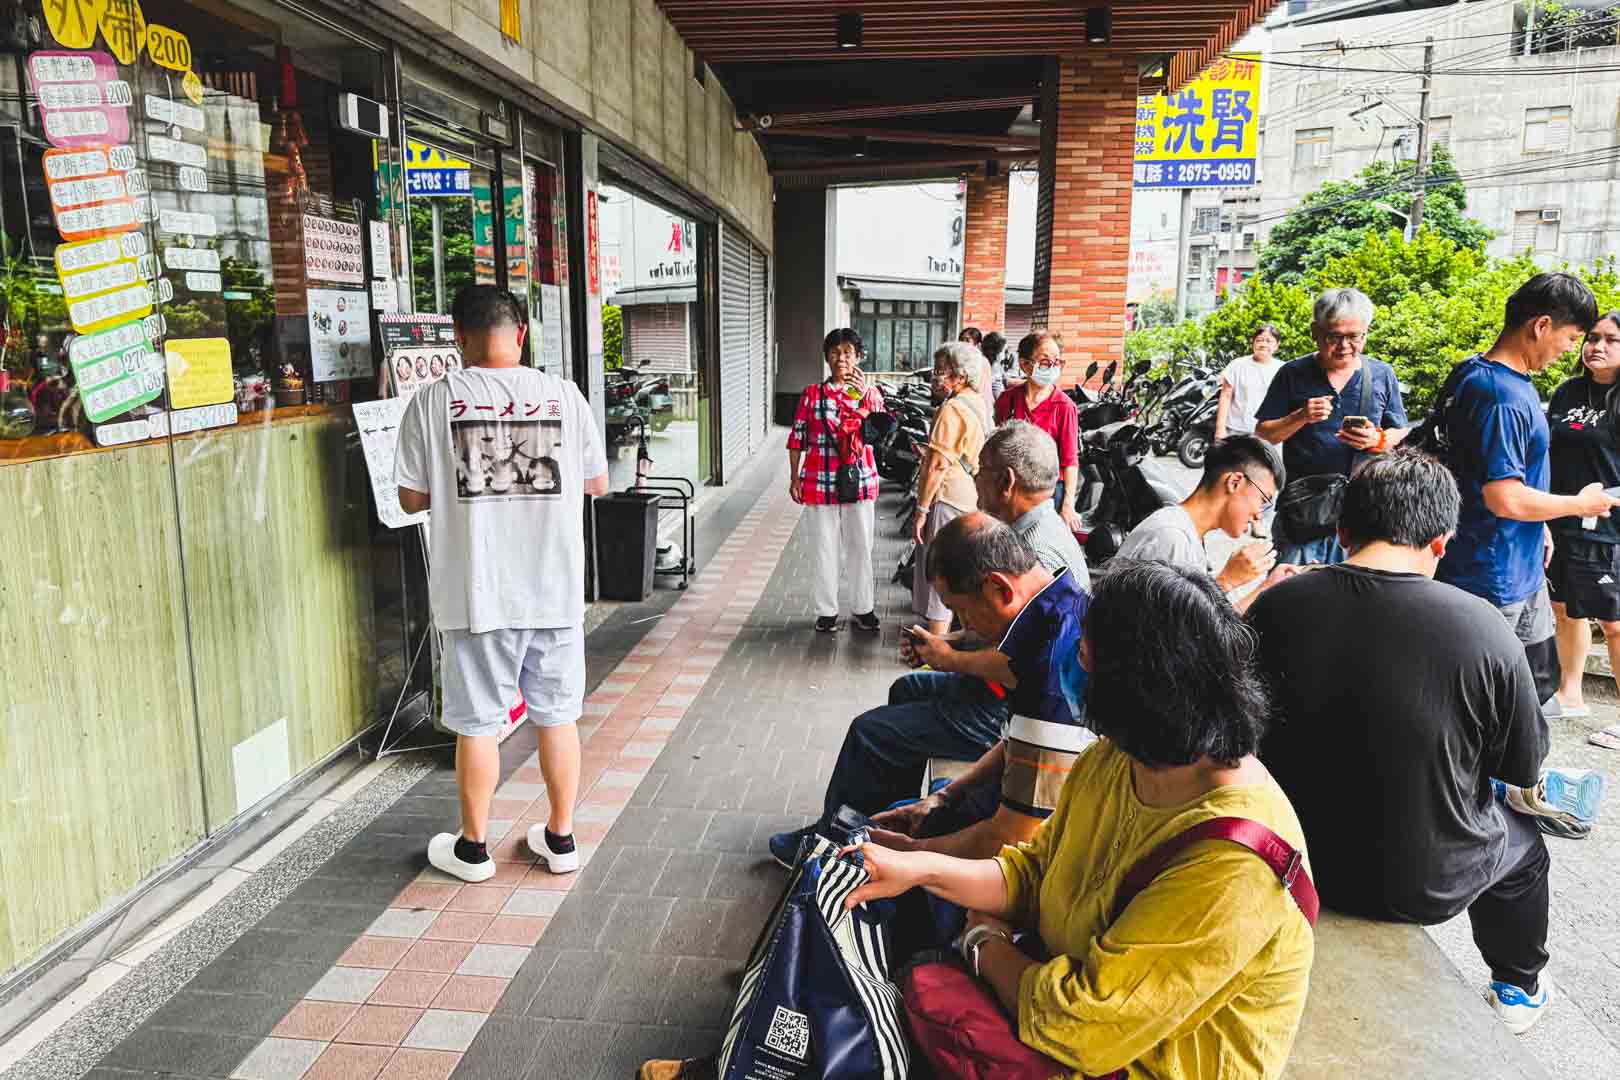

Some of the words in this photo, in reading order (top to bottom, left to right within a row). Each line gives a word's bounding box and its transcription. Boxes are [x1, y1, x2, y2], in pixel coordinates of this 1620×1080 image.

[150, 31, 190, 67] 200
[1200, 60, 1256, 81] 診所
[108, 83, 129, 104] 200
[1163, 89, 1253, 153] 洗腎
[111, 148, 135, 169] 300
[449, 400, 541, 418] ラーメン
